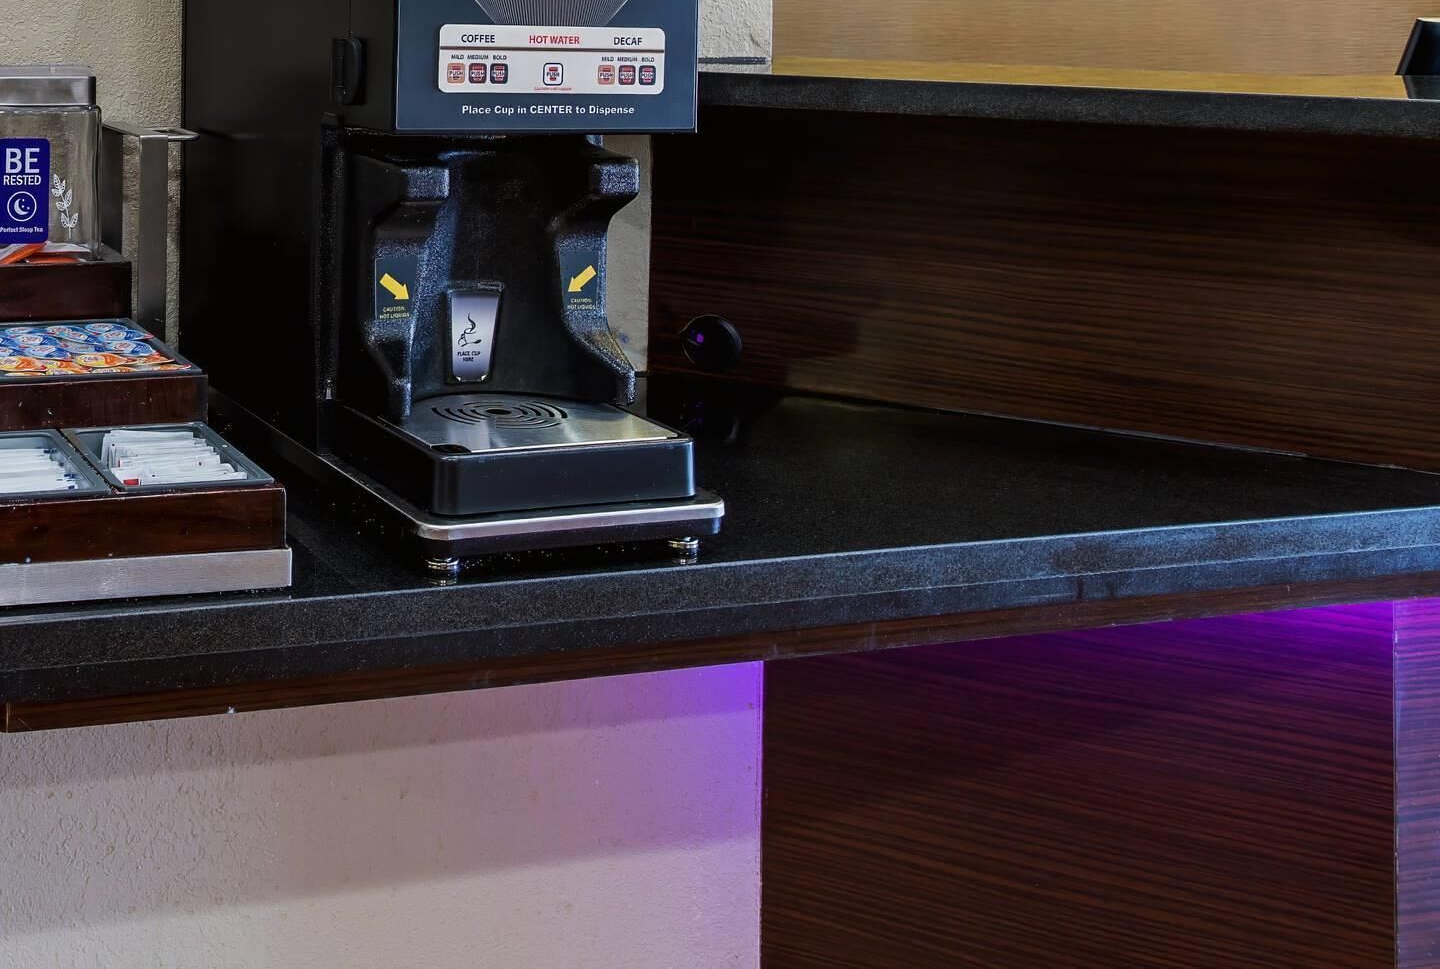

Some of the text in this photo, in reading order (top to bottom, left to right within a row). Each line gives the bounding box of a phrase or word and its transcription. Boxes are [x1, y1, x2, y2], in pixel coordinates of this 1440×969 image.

[461, 34, 495, 43] COFFEE
[529, 35, 580, 44] HOT WATER
[614, 37, 642, 45] DECAF
[462, 106, 491, 114] Place
[494, 106, 514, 116] Cup
[518, 106, 526, 114] in
[530, 106, 572, 114] CENTER
[589, 106, 634, 116] Dispense
[6, 148, 40, 173] BE
[4, 175, 41, 185] RESTED
